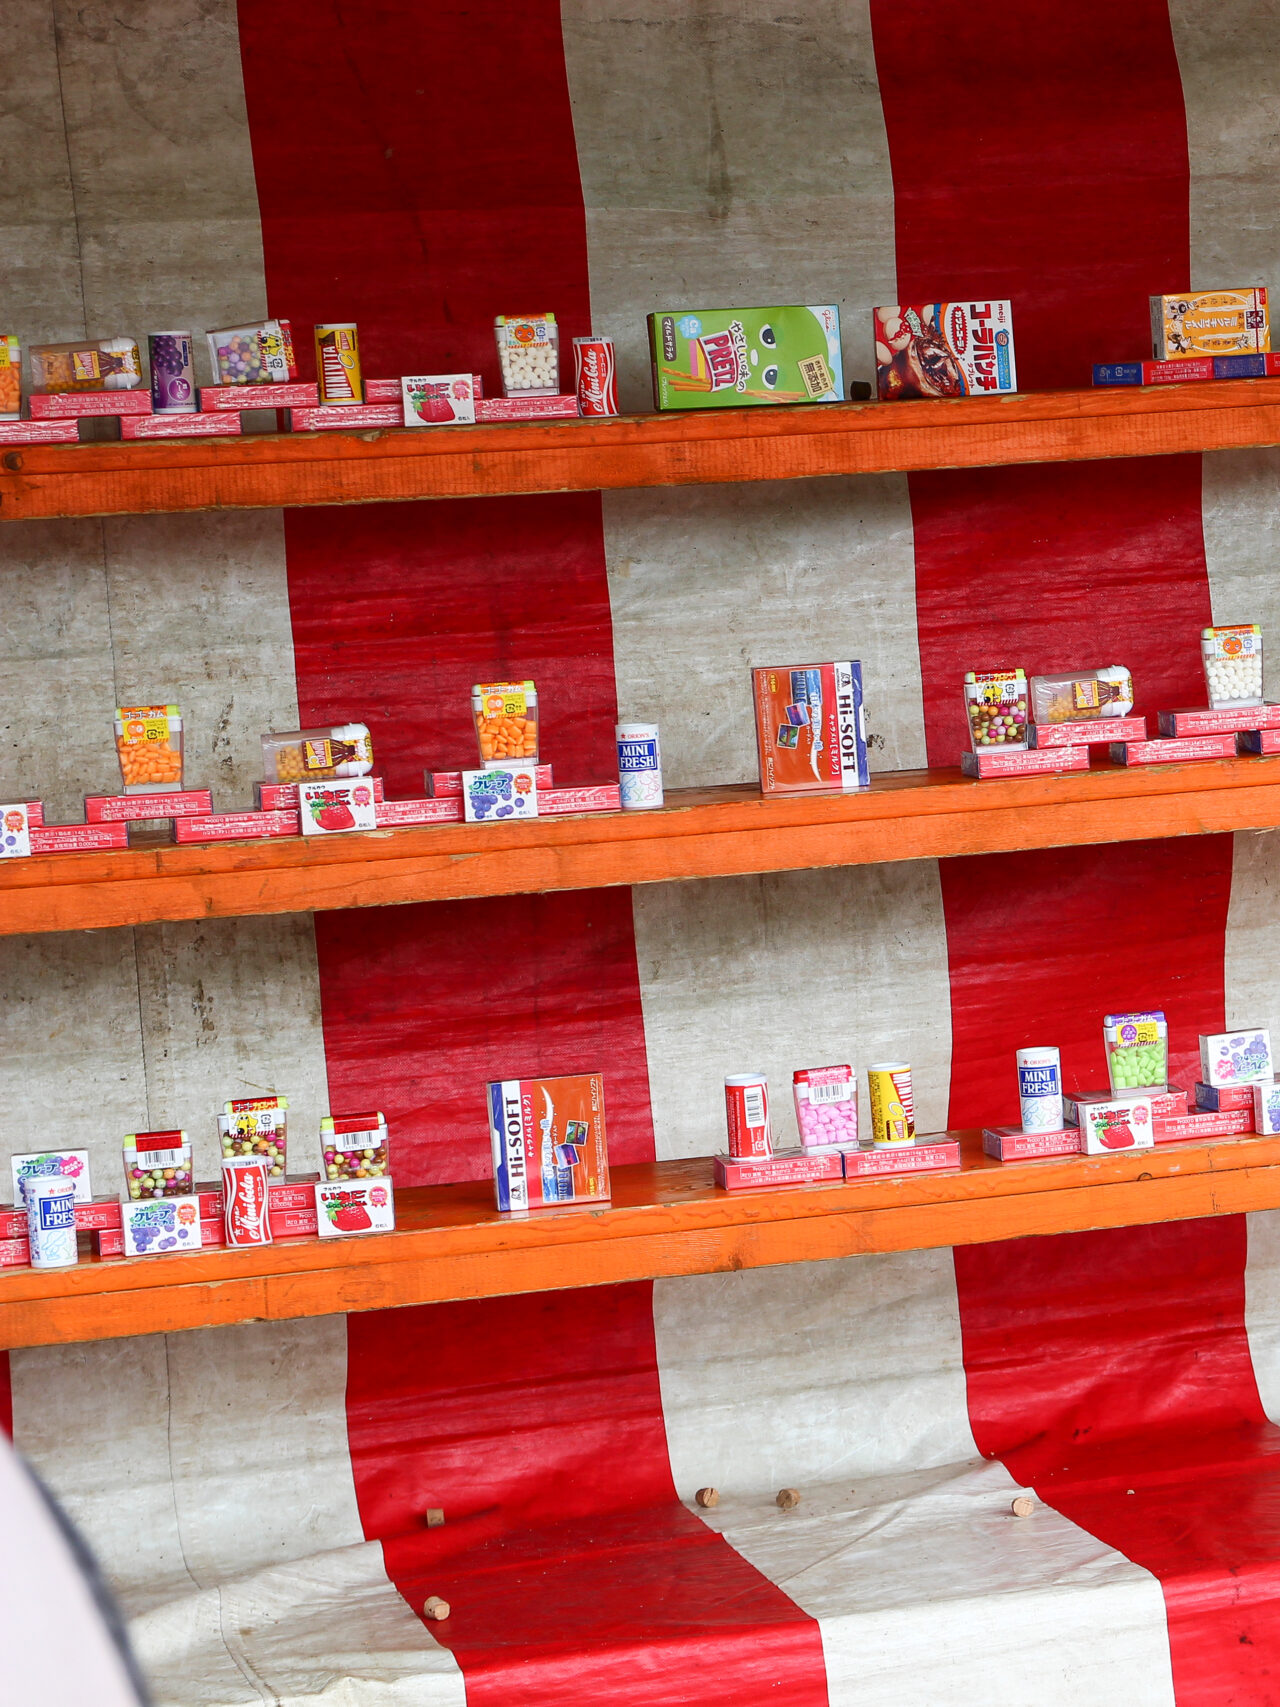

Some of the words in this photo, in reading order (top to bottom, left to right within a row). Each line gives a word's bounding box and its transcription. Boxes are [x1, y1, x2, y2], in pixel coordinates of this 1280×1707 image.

[998, 304, 1006, 323] meiji
[664, 319, 676, 360] マイルドサラダ
[970, 304, 997, 391] コーラパンチ
[731, 322, 750, 392] やさしい味の
[323, 346, 352, 398] MINIVITA
[338, 353, 355, 369] C
[803, 362, 822, 394] 無添加
[406, 382, 450, 393] いちご
[483, 686, 522, 694] ゴーゴーガム
[124, 710, 165, 719] ゴーゴーガム
[838, 694, 856, 772] Hi-SOFT
[622, 744, 650, 756] MINI
[620, 756, 654, 768] FRESH
[472, 780, 509, 790] グレープ
[305, 790, 350, 800] いちご
[1024, 1070, 1051, 1082] MINI
[1022, 1082, 1056, 1094] FRESH
[892, 1072, 914, 1124] MINIVITA
[888, 1102, 906, 1118] C
[1090, 1108, 1131, 1120] いちご
[506, 1097, 524, 1178] Hi-SOFT
[21, 1164, 57, 1175] グレープ
[320, 1190, 368, 1201] いちご
[45, 1212, 75, 1226] FRES
[134, 1210, 171, 1222] グレープ
